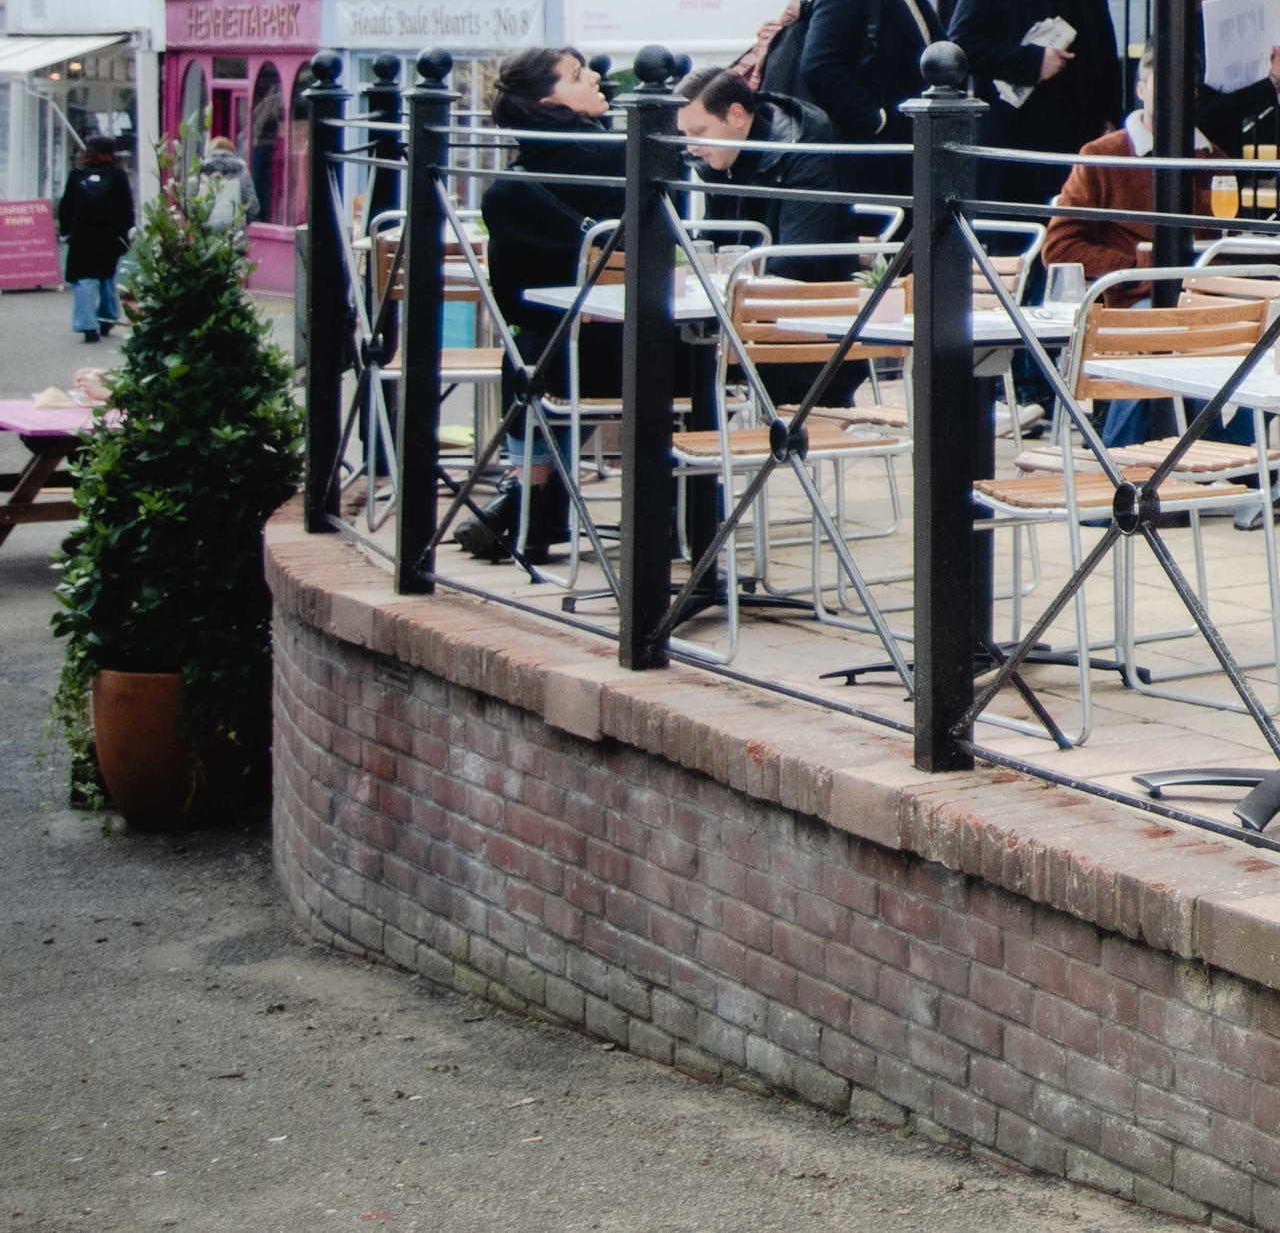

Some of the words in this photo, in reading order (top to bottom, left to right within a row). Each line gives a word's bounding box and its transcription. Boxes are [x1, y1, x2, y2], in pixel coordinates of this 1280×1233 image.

[187, 4, 261, 38] HENRIETTA
[261, 3, 301, 37] PARK
[350, 6, 394, 36] Heads
[399, 5, 429, 36] Rule
[432, 5, 480, 36] Hearts
[493, 7, 517, 37] No
[521, 9, 531, 36] 8
[0, 203, 49, 216] ENRIETTA
